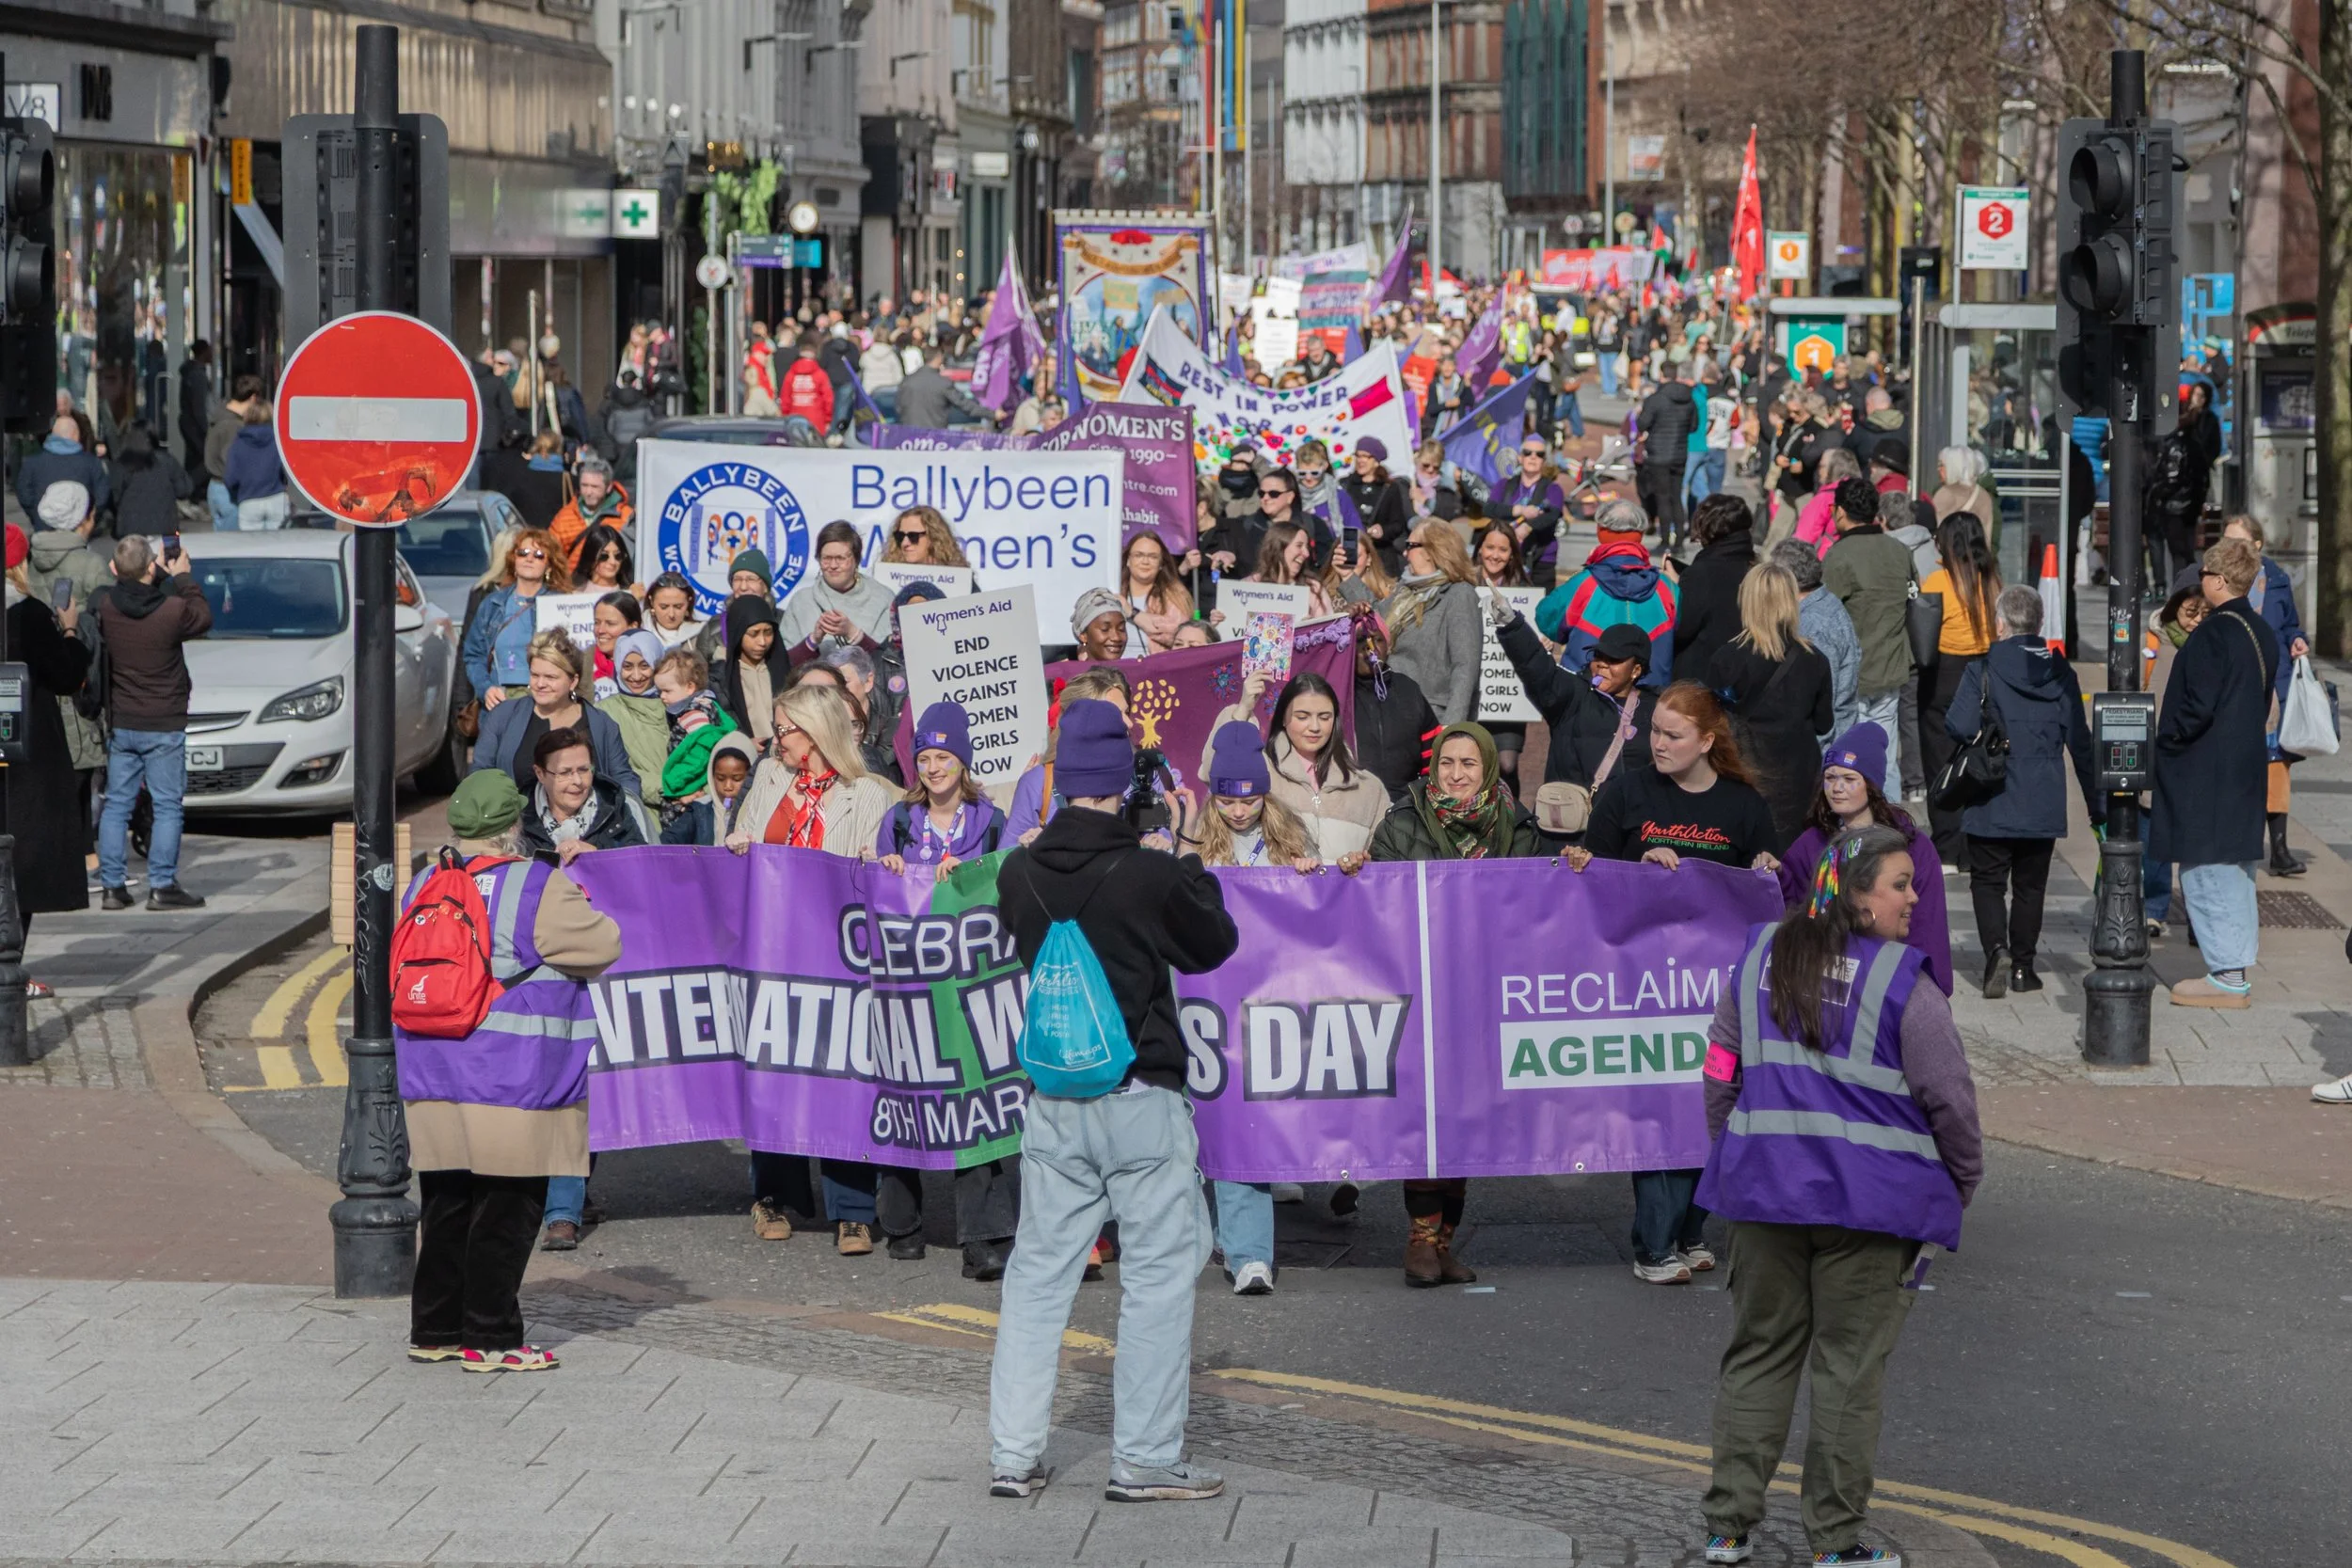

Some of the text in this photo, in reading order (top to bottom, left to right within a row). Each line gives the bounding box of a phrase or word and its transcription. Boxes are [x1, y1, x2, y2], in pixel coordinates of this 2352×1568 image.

[8, 94, 46, 119] V8
[1988, 212, 2004, 233] 2
[1807, 350, 1820, 367] 1
[1180, 361, 1225, 400] REST
[1235, 395, 1258, 412] IN
[1272, 386, 1348, 415] POWER
[1072, 414, 1185, 441] WOMEN'S
[665, 465, 804, 532] BALLYBEEN
[851, 465, 1110, 522] Ballybeen
[1122, 507, 1160, 525] habit
[860, 523, 1097, 570] men's
[890, 572, 955, 584] Women's Aid
[556, 602, 595, 610] Women'
[1232, 589, 1294, 602] Women's Aid
[1512, 595, 1529, 605] Aid
[922, 599, 1012, 627] Women's Aid
[954, 636, 990, 655] END
[931, 655, 1018, 683] VIOLENCE
[942, 680, 1017, 704] AGAINST
[1486, 686, 1518, 696] GIRLS
[968, 705, 1018, 727] OMEN
[1480, 703, 1512, 713] NOW
[970, 730, 1019, 752] GIRLS
[191, 751, 217, 765] CJ
[970, 756, 1012, 776] NOW
[1641, 820, 1730, 843] YouthAction
[1647, 837, 1694, 848] NORTHERN
[843, 911, 1016, 975] CLEBR
[588, 972, 956, 1084] NTERNATIONAL
[1249, 1003, 1402, 1093] DAY
[1508, 1032, 1708, 1077] AGEND
[873, 1085, 1027, 1143] 8TH MAR
